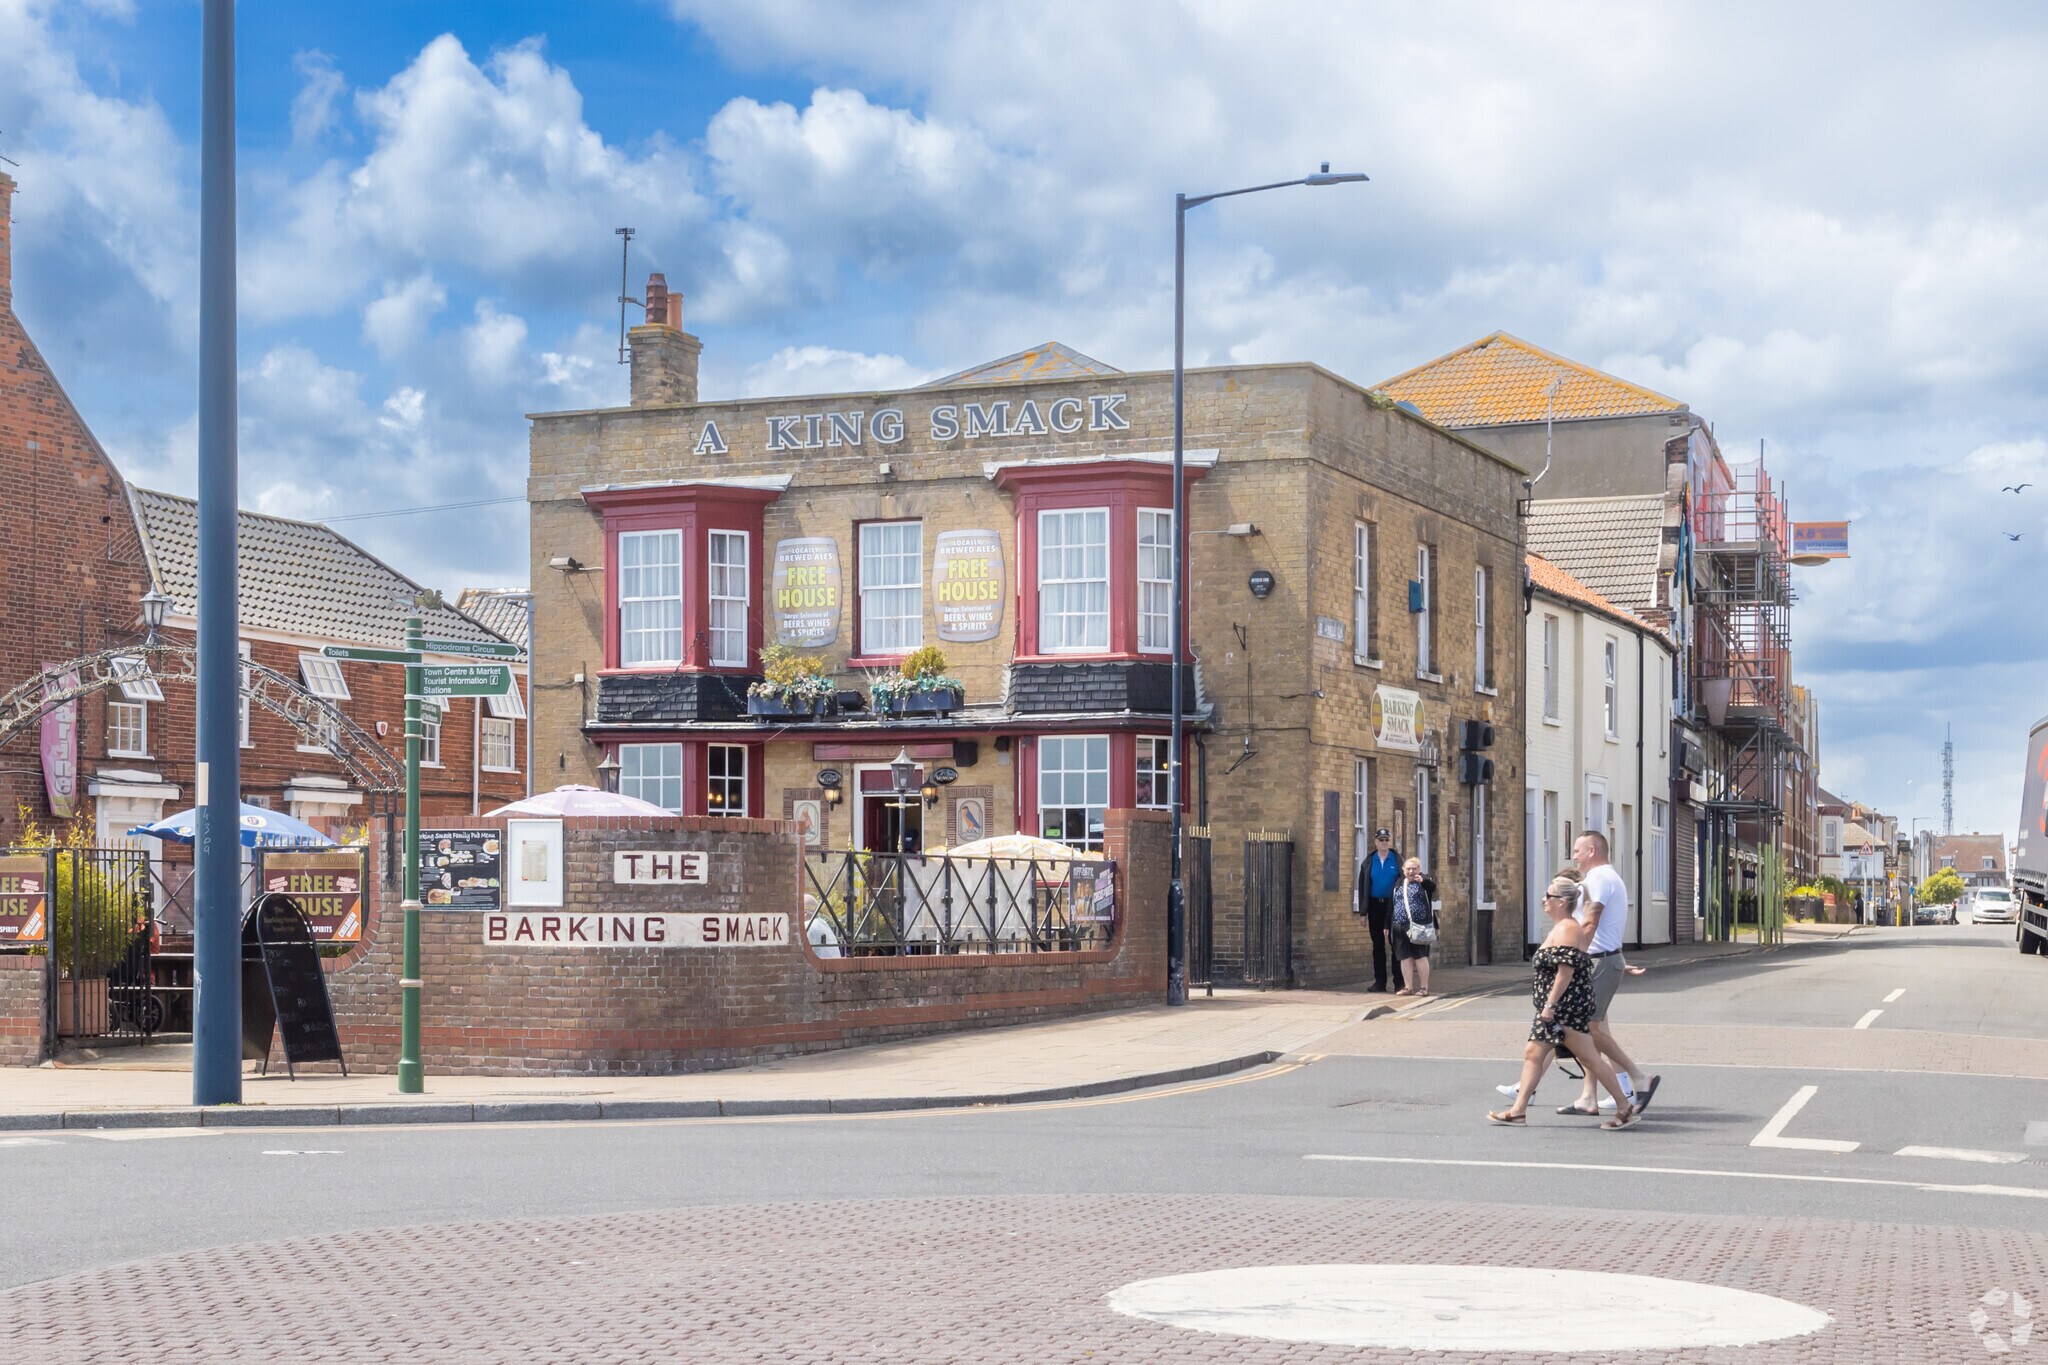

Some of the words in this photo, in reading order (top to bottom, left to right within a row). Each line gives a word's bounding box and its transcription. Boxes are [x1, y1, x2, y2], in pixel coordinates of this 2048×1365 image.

[694, 420, 728, 455] A
[766, 408, 904, 451] KING
[930, 394, 1130, 441] SMACK
[791, 546, 820, 554] LOCALLY
[940, 546, 974, 554] BREWED
[976, 545, 996, 553] ALES
[780, 553, 812, 562] BREWED
[814, 552, 833, 560] ALES
[948, 558, 990, 579] FREE
[787, 564, 827, 587] FREE
[938, 580, 999, 602] HOUSE
[778, 586, 836, 609] HOUSE
[968, 612, 993, 621] WINES
[807, 619, 831, 628] WINES
[951, 623, 957, 631] &
[959, 622, 987, 631] SPIRITS
[790, 629, 796, 637] &
[798, 628, 825, 637] SPIRITS
[328, 648, 349, 657] Toilets
[426, 642, 470, 653] Hippodrome
[472, 644, 496, 654] Circus
[424, 668, 442, 676] Town
[444, 668, 468, 676] Centre
[469, 667, 475, 676] &
[476, 667, 502, 676] Market
[424, 677, 447, 686] Tourist
[448, 676, 488, 686] Information
[423, 686, 452, 694] Stations
[1384, 699, 1414, 718] BARKING
[1387, 716, 1410, 734] SMACK
[419, 832, 434, 841] rking
[452, 831, 470, 842] Family
[622, 854, 700, 880] THE
[1, 877, 20, 893] EE
[290, 874, 334, 892] FREE
[294, 898, 343, 916] OUSE
[488, 916, 666, 942] BARKING
[702, 916, 782, 942] SMACK
